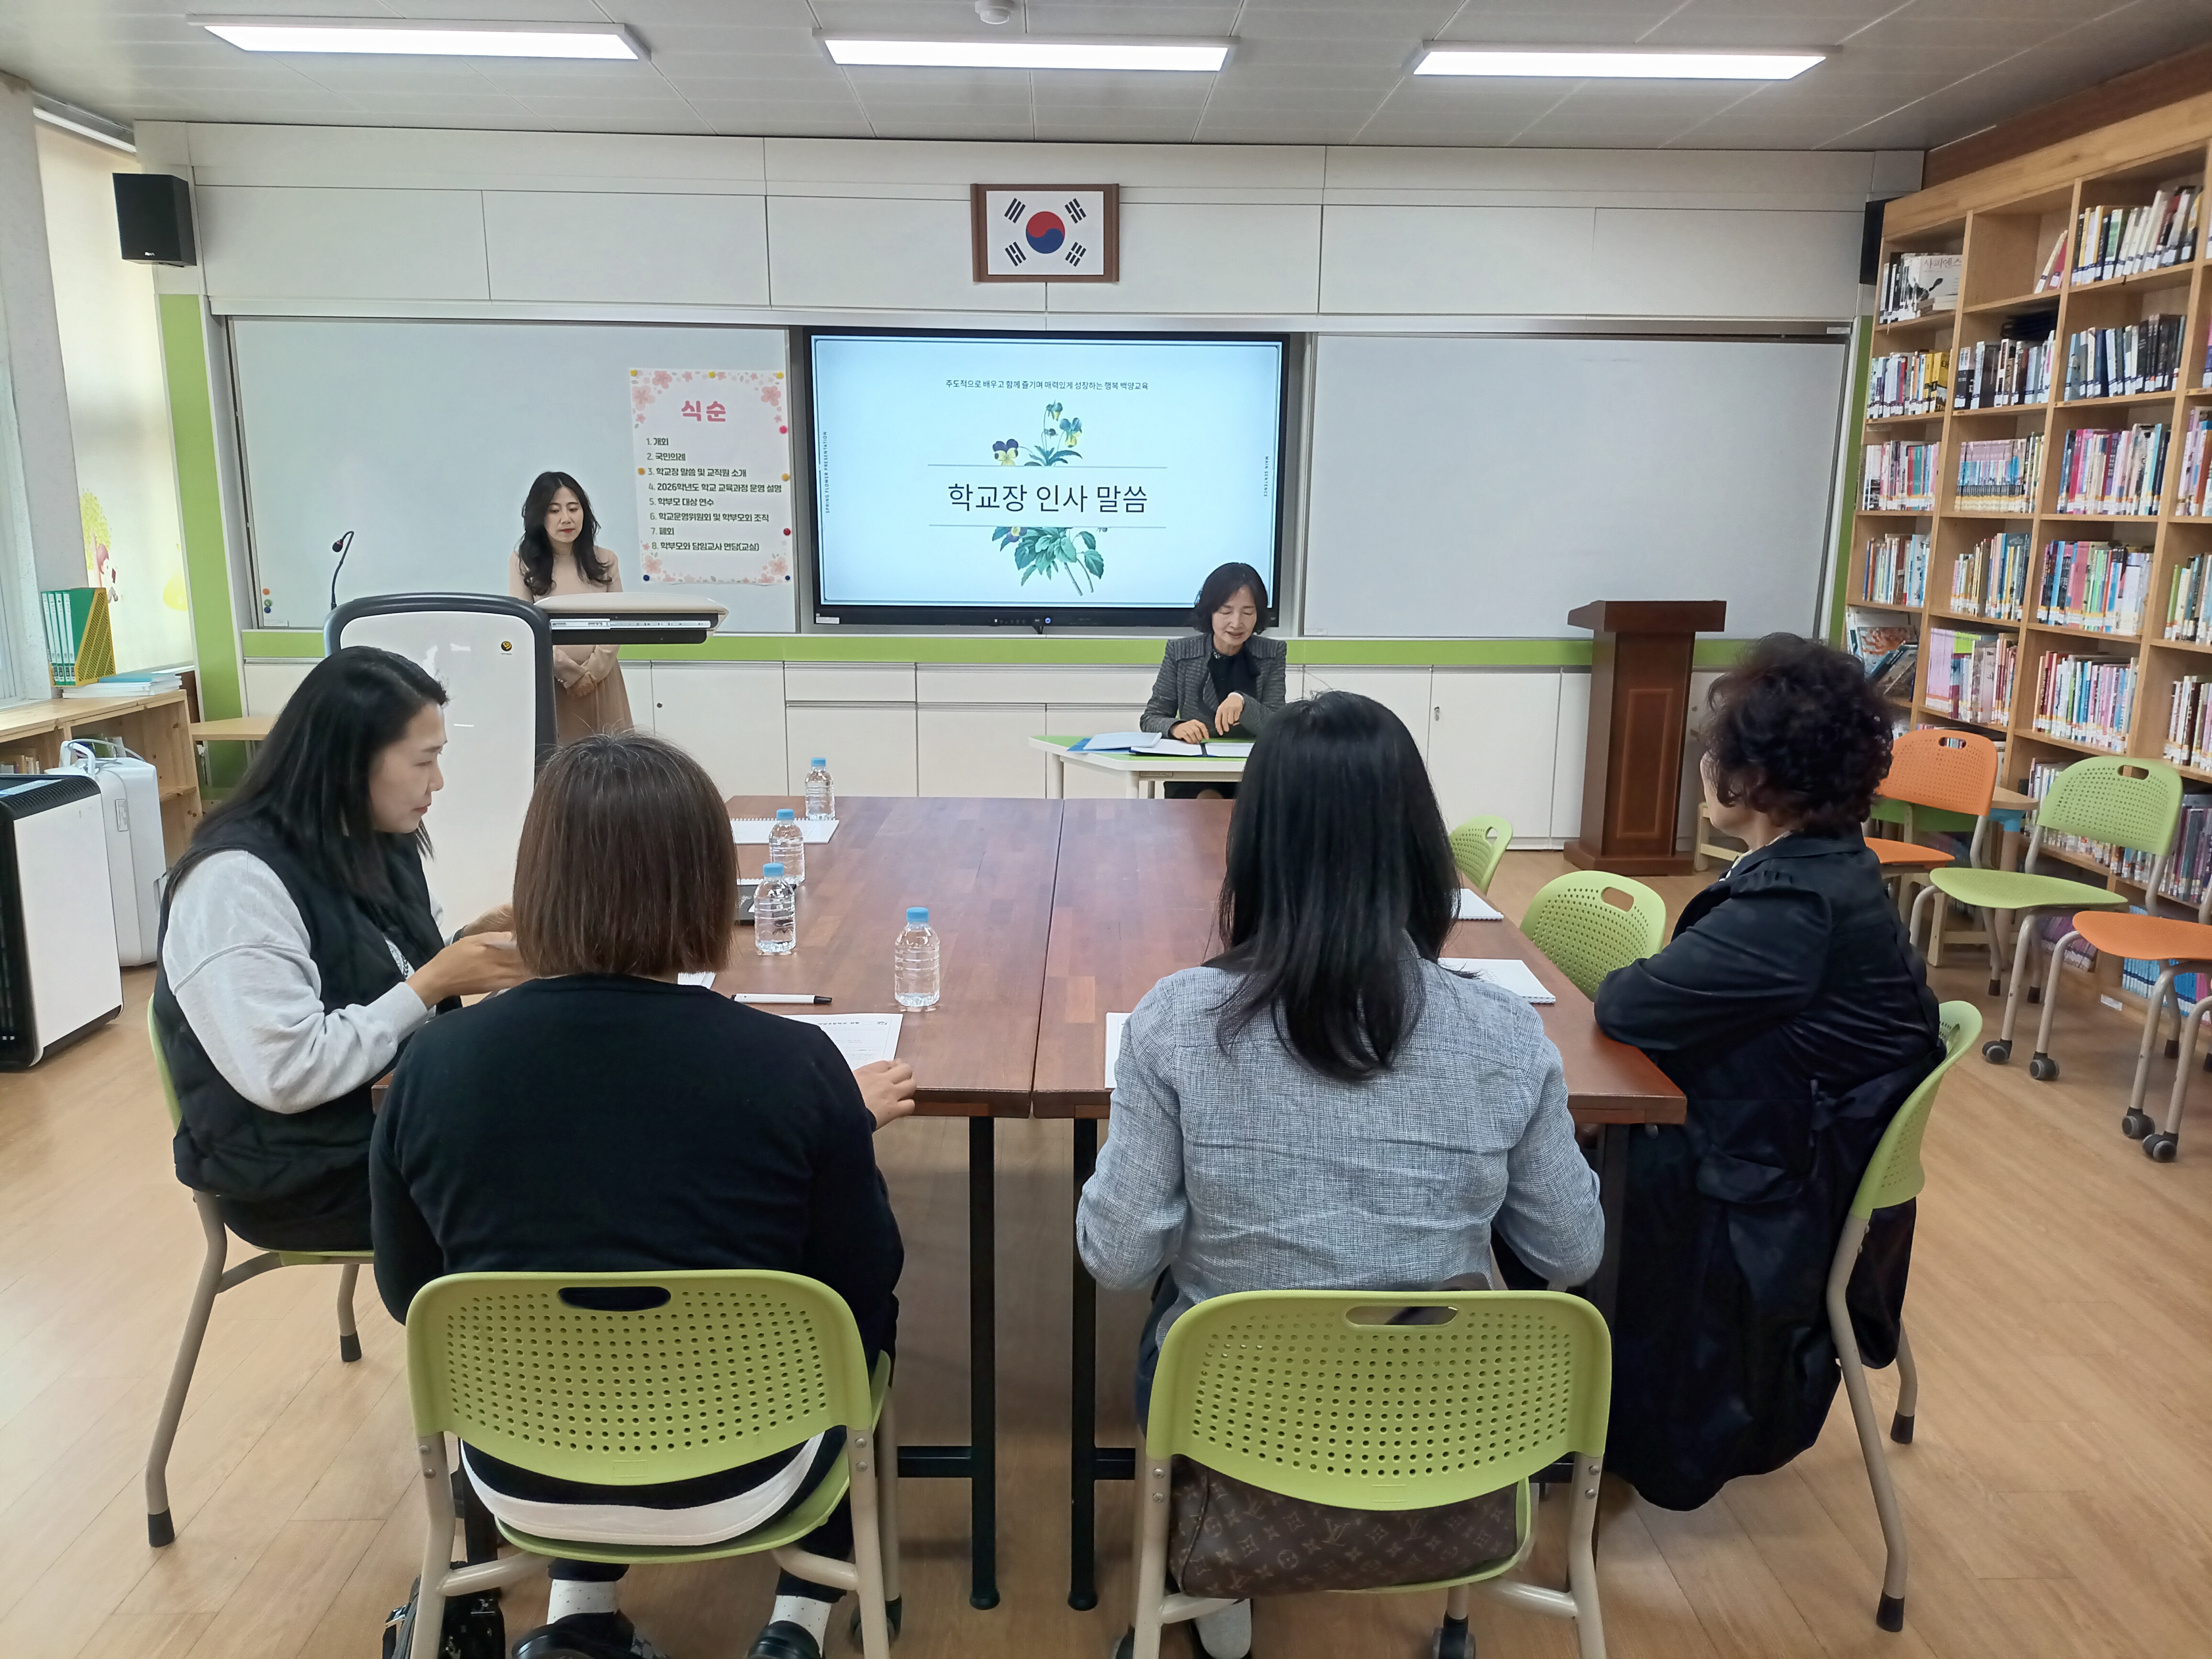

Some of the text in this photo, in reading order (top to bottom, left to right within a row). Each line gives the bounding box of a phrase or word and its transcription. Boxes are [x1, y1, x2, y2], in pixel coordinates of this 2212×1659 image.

[946, 380, 1149, 390] 주도적으로 배우고 함께 즐기며 매력있게 성장하는 행복 백양교육
[655, 453, 686, 461] 국민의례
[656, 468, 679, 476] 학교장
[681, 468, 696, 476] 말씀
[697, 468, 705, 476] 및
[707, 468, 730, 476] 교직원
[657, 483, 699, 491] 2026학년도
[719, 484, 748, 492] 교육과정
[750, 484, 764, 492] 운영
[767, 485, 782, 493] 설명
[948, 483, 1147, 512] 학교장 인사 말씀
[658, 498, 680, 506] 학부모
[682, 498, 697, 506] 대상
[699, 498, 714, 506] 연수
[659, 513, 711, 521] 학교운영위원회
[722, 513, 752, 521] 학부모회
[661, 542, 691, 550] 학부모와
[692, 542, 722, 551] 담임교사
[724, 542, 759, 551] 면담(교실)
